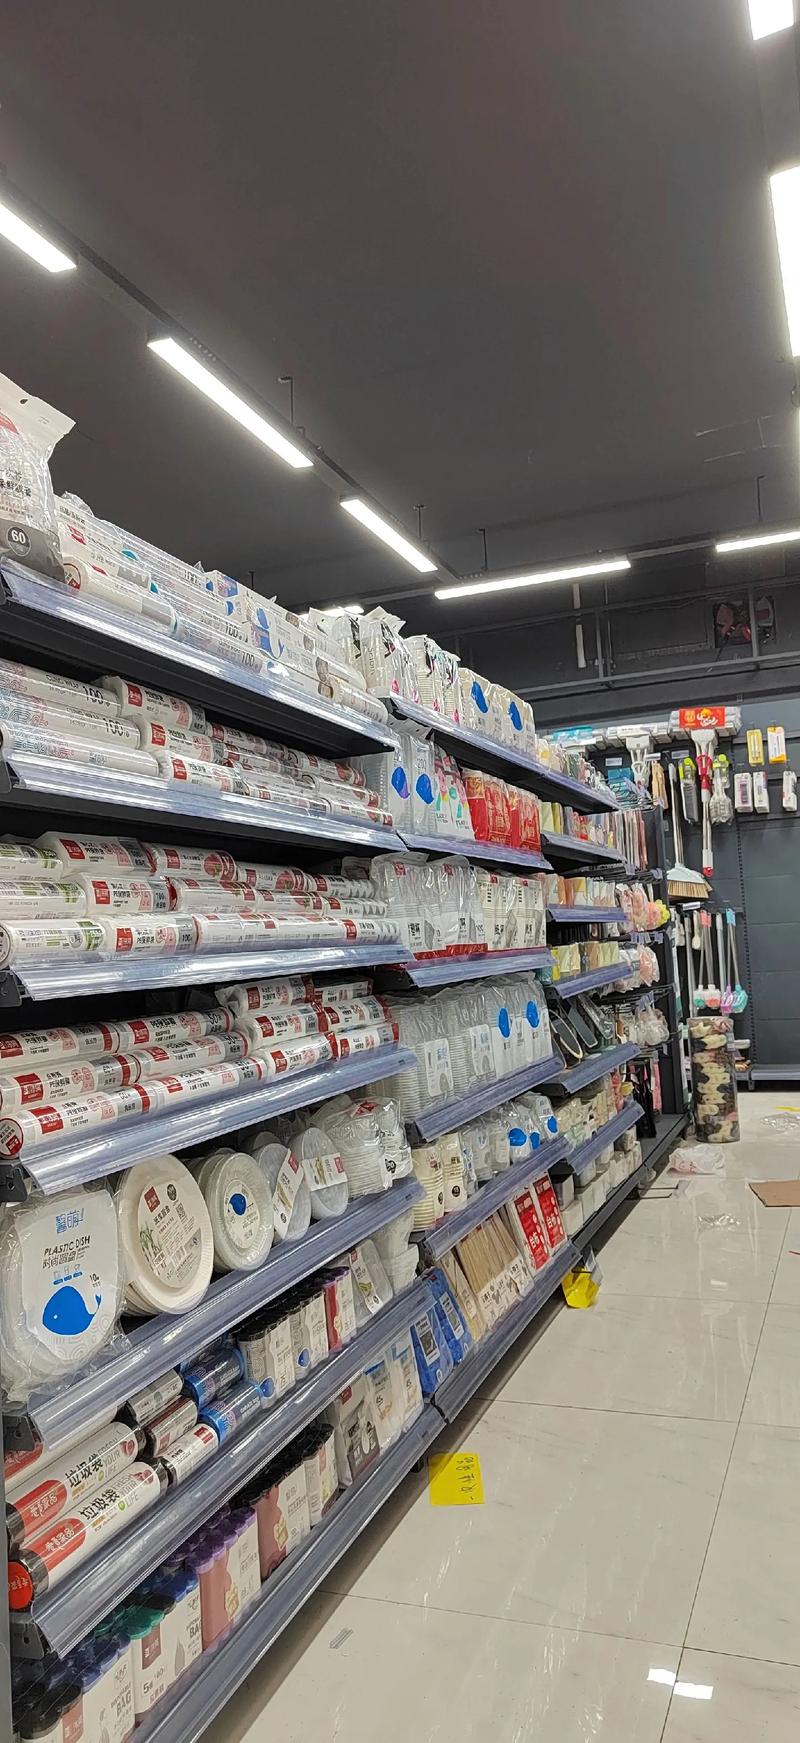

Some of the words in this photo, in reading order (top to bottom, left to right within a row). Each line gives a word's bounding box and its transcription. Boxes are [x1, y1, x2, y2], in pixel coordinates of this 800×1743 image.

[11, 530, 26, 544] 60
[44, 1241, 74, 1257] PLASTIC
[75, 1235, 91, 1249] DISH
[65, 1453, 104, 1488] 垃圾袋
[78, 1488, 120, 1521] 垃圾袋
[116, 1691, 132, 1717] BAG
